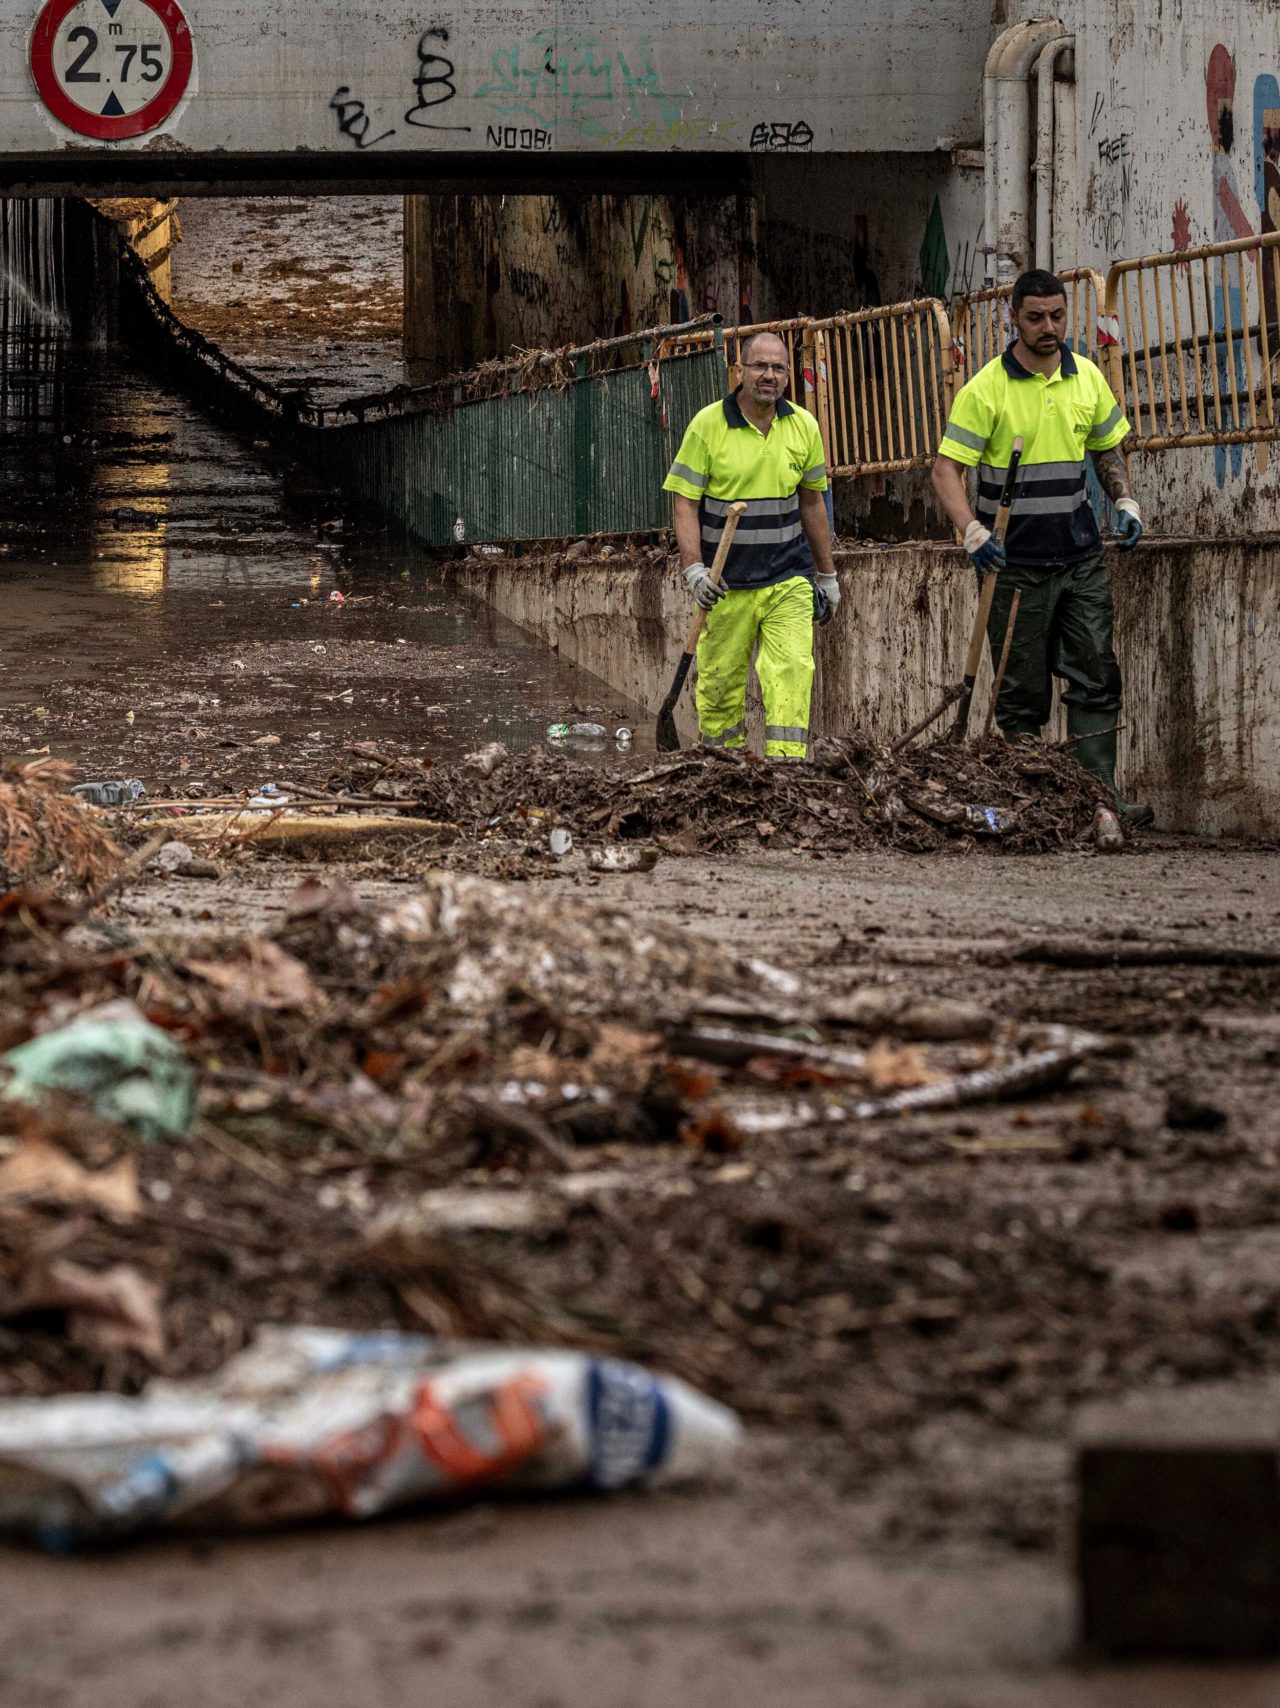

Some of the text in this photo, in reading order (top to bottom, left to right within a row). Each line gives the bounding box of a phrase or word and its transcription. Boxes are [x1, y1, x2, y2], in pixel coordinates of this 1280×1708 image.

[109, 23, 122, 35] m
[65, 26, 163, 83] 2.75
[1098, 133, 1133, 167] FREE
